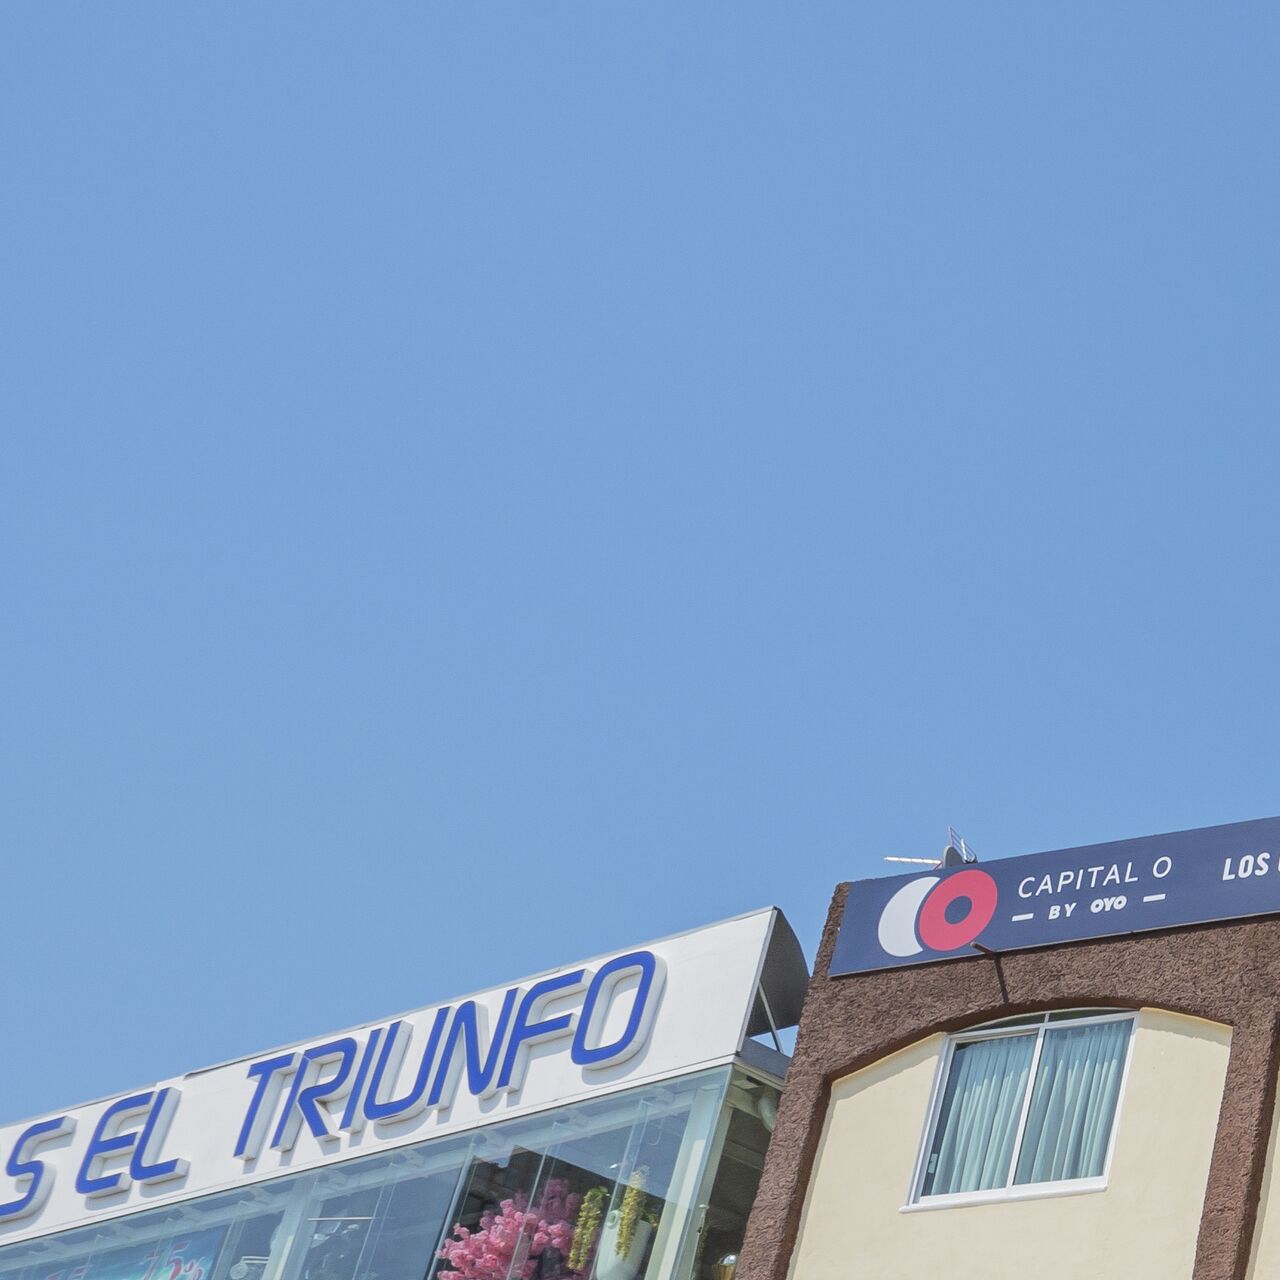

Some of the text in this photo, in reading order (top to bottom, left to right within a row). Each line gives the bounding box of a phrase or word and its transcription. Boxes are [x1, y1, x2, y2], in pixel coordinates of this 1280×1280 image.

[1018, 856, 1172, 899] CAPITAL O
[1222, 852, 1271, 881] LOS
[1048, 895, 1127, 920] BY OYO
[74, 1088, 188, 1196] EL
[233, 950, 666, 1160] TRIUNFO
